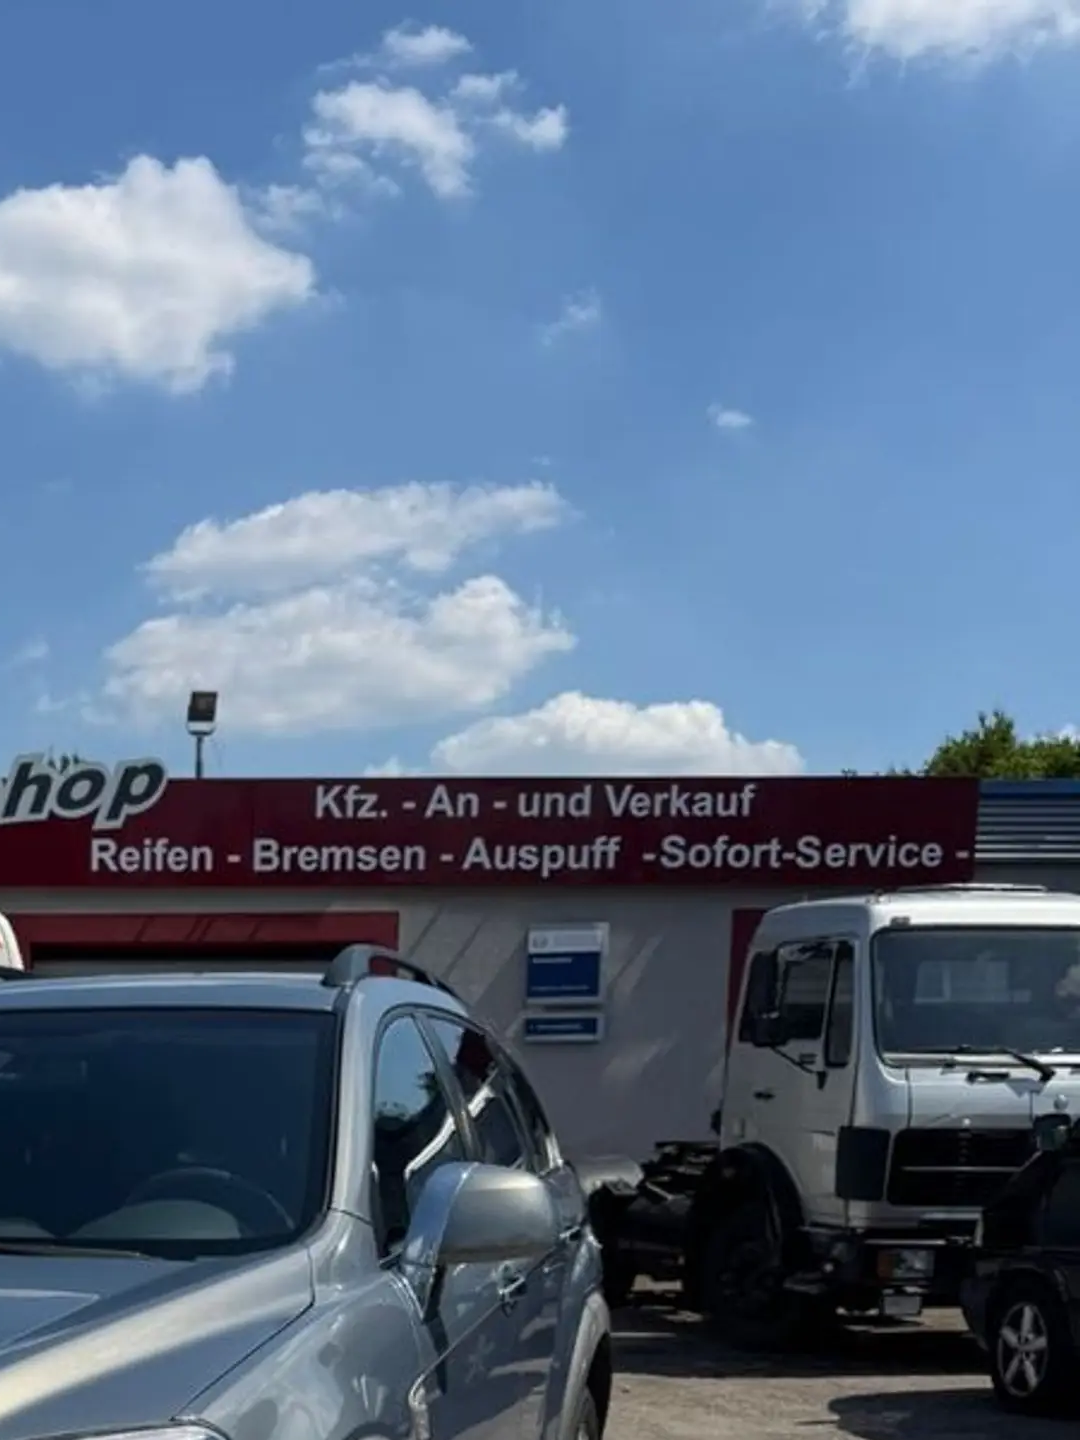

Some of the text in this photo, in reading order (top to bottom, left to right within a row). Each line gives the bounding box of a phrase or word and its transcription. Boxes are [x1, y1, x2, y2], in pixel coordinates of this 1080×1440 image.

[315, 785, 388, 819] Kfz.
[424, 784, 479, 818] An
[518, 785, 591, 817] und
[604, 784, 756, 818] Verkauf
[90, 838, 214, 872] Reifen
[253, 840, 426, 872] Bremsen
[462, 836, 621, 877] Auspuff
